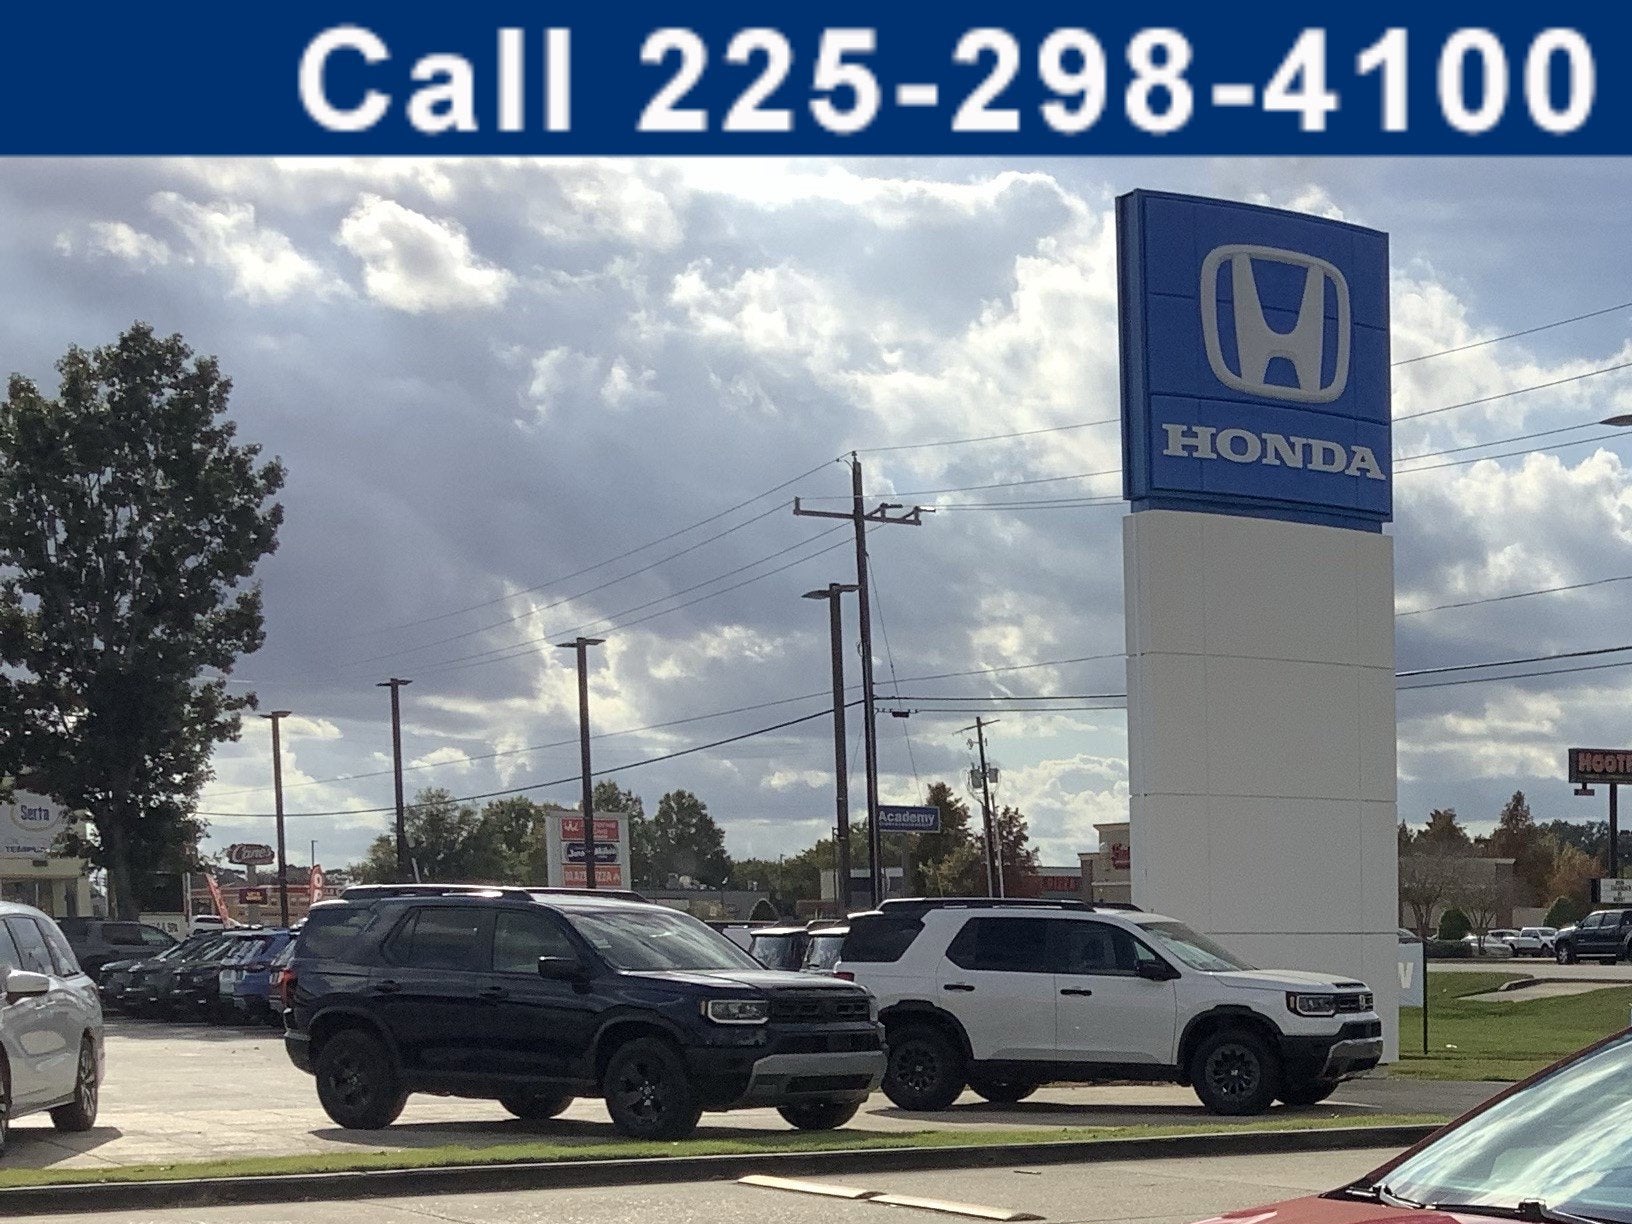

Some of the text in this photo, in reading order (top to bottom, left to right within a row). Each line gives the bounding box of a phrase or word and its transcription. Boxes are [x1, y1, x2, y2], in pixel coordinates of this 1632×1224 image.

[1162, 423, 1386, 480] HONDA
[20, 805, 50, 820] Serta
[879, 811, 935, 827] Academy
